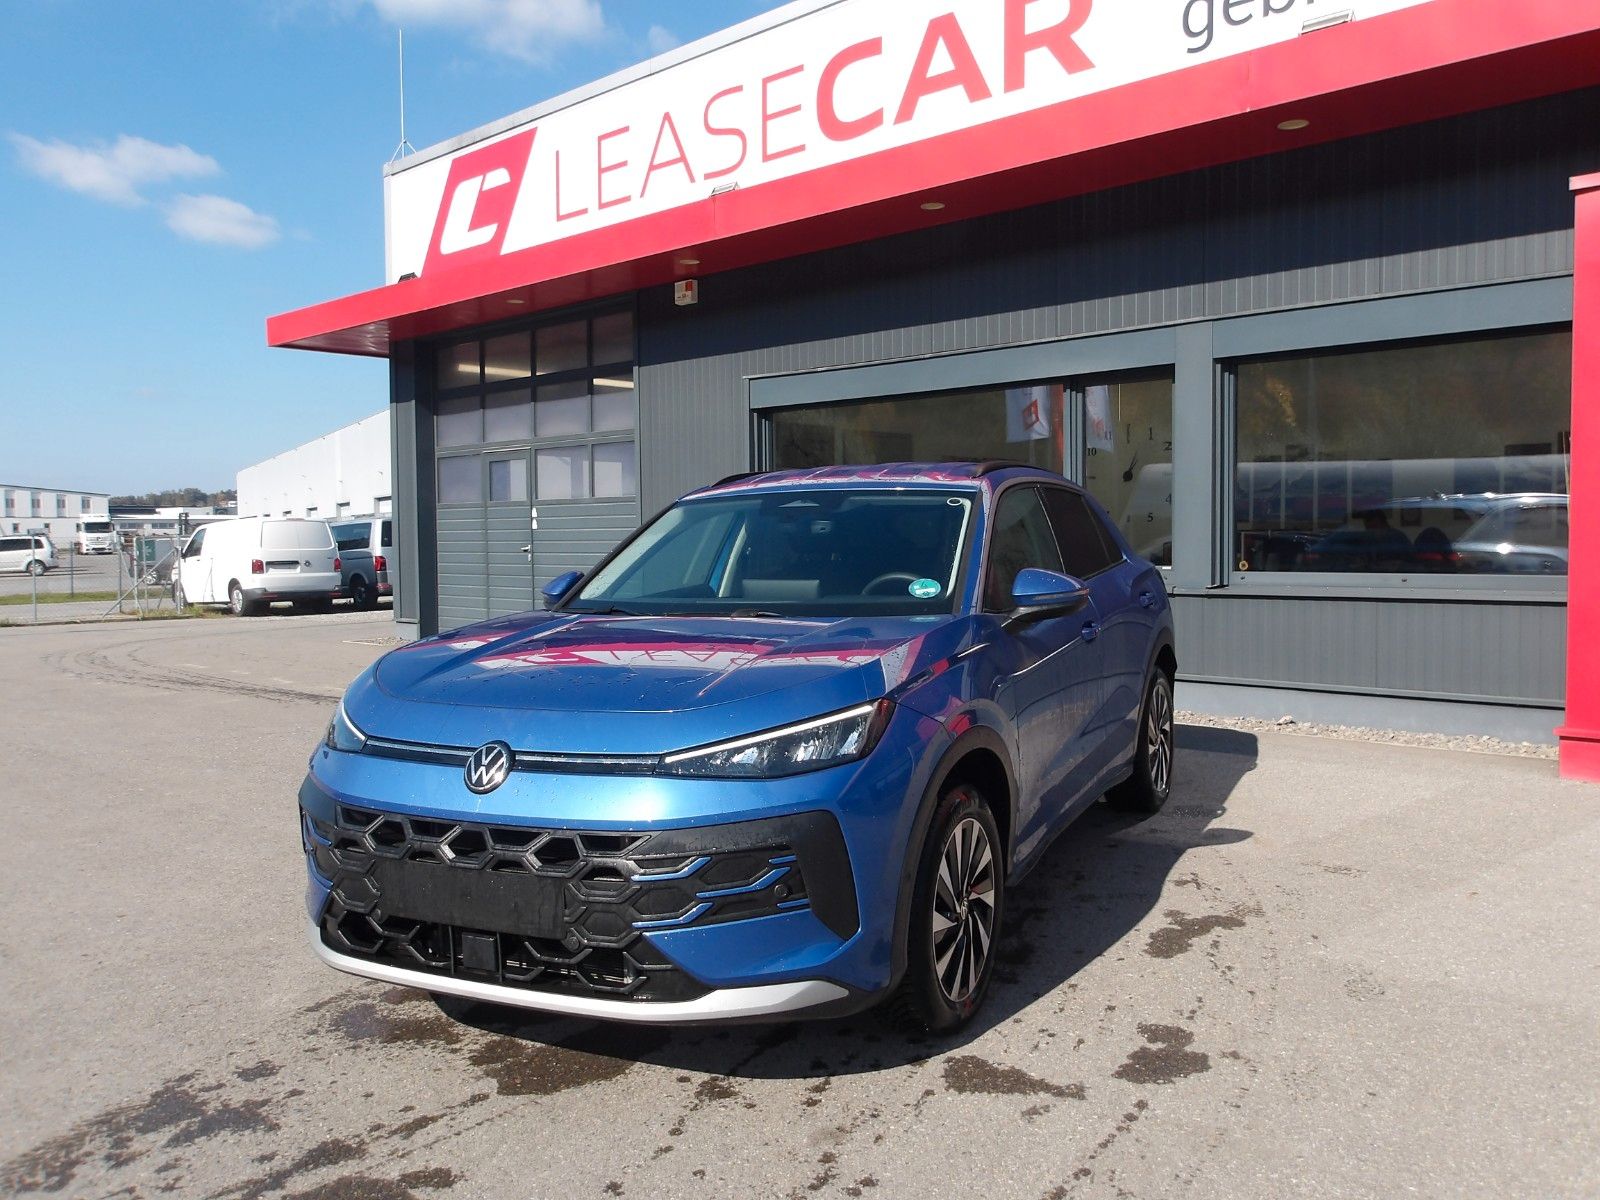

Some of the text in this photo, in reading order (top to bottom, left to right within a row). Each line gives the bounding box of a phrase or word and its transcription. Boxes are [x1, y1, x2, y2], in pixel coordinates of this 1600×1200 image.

[555, 0, 1096, 223] LEASECAR
[1087, 447, 1097, 457] 10
[1147, 512, 1154, 523] 5
